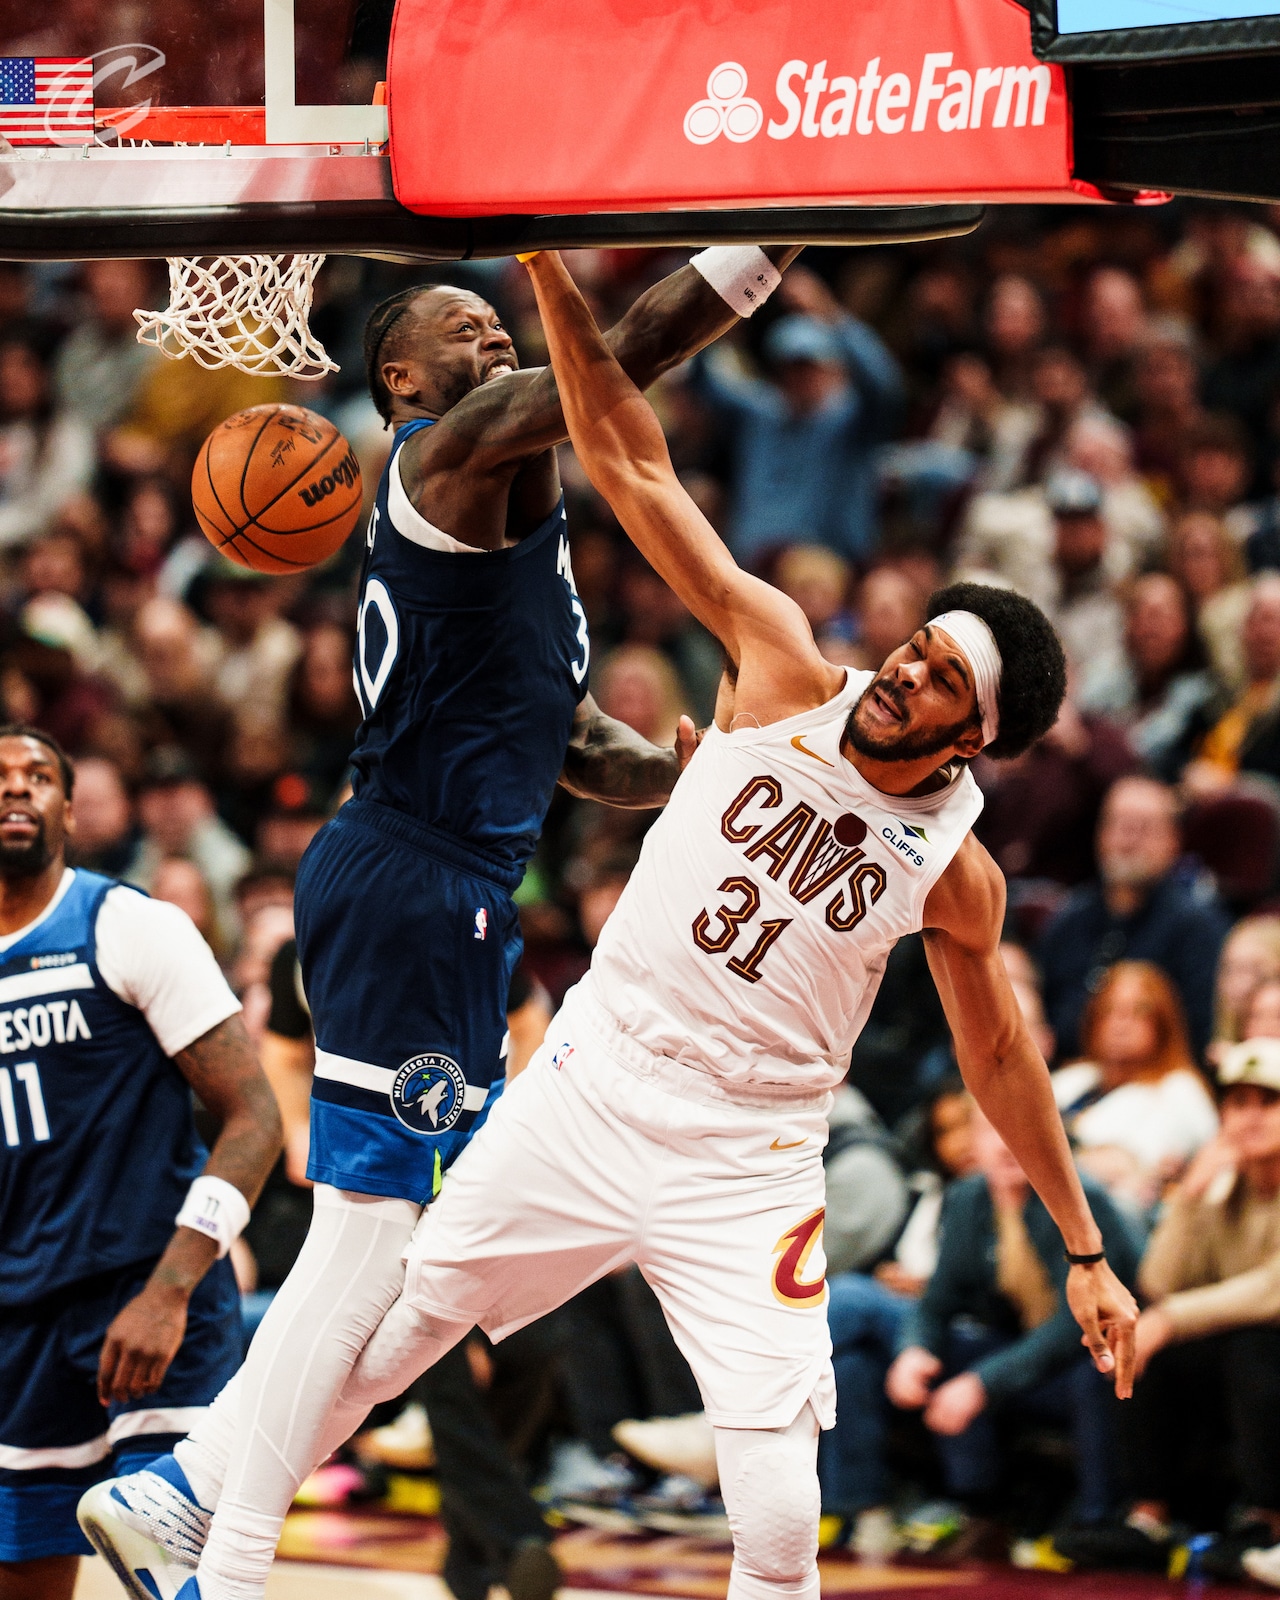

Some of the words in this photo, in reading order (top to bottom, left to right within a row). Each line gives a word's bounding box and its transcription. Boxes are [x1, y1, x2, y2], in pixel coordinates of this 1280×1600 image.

[721, 775, 887, 932] CAVS
[882, 827, 925, 867] CLIFFS
[692, 876, 794, 983] 31
[394, 1058, 436, 1098] MINNESOTA
[440, 1059, 464, 1126] TIMBERWOLVES
